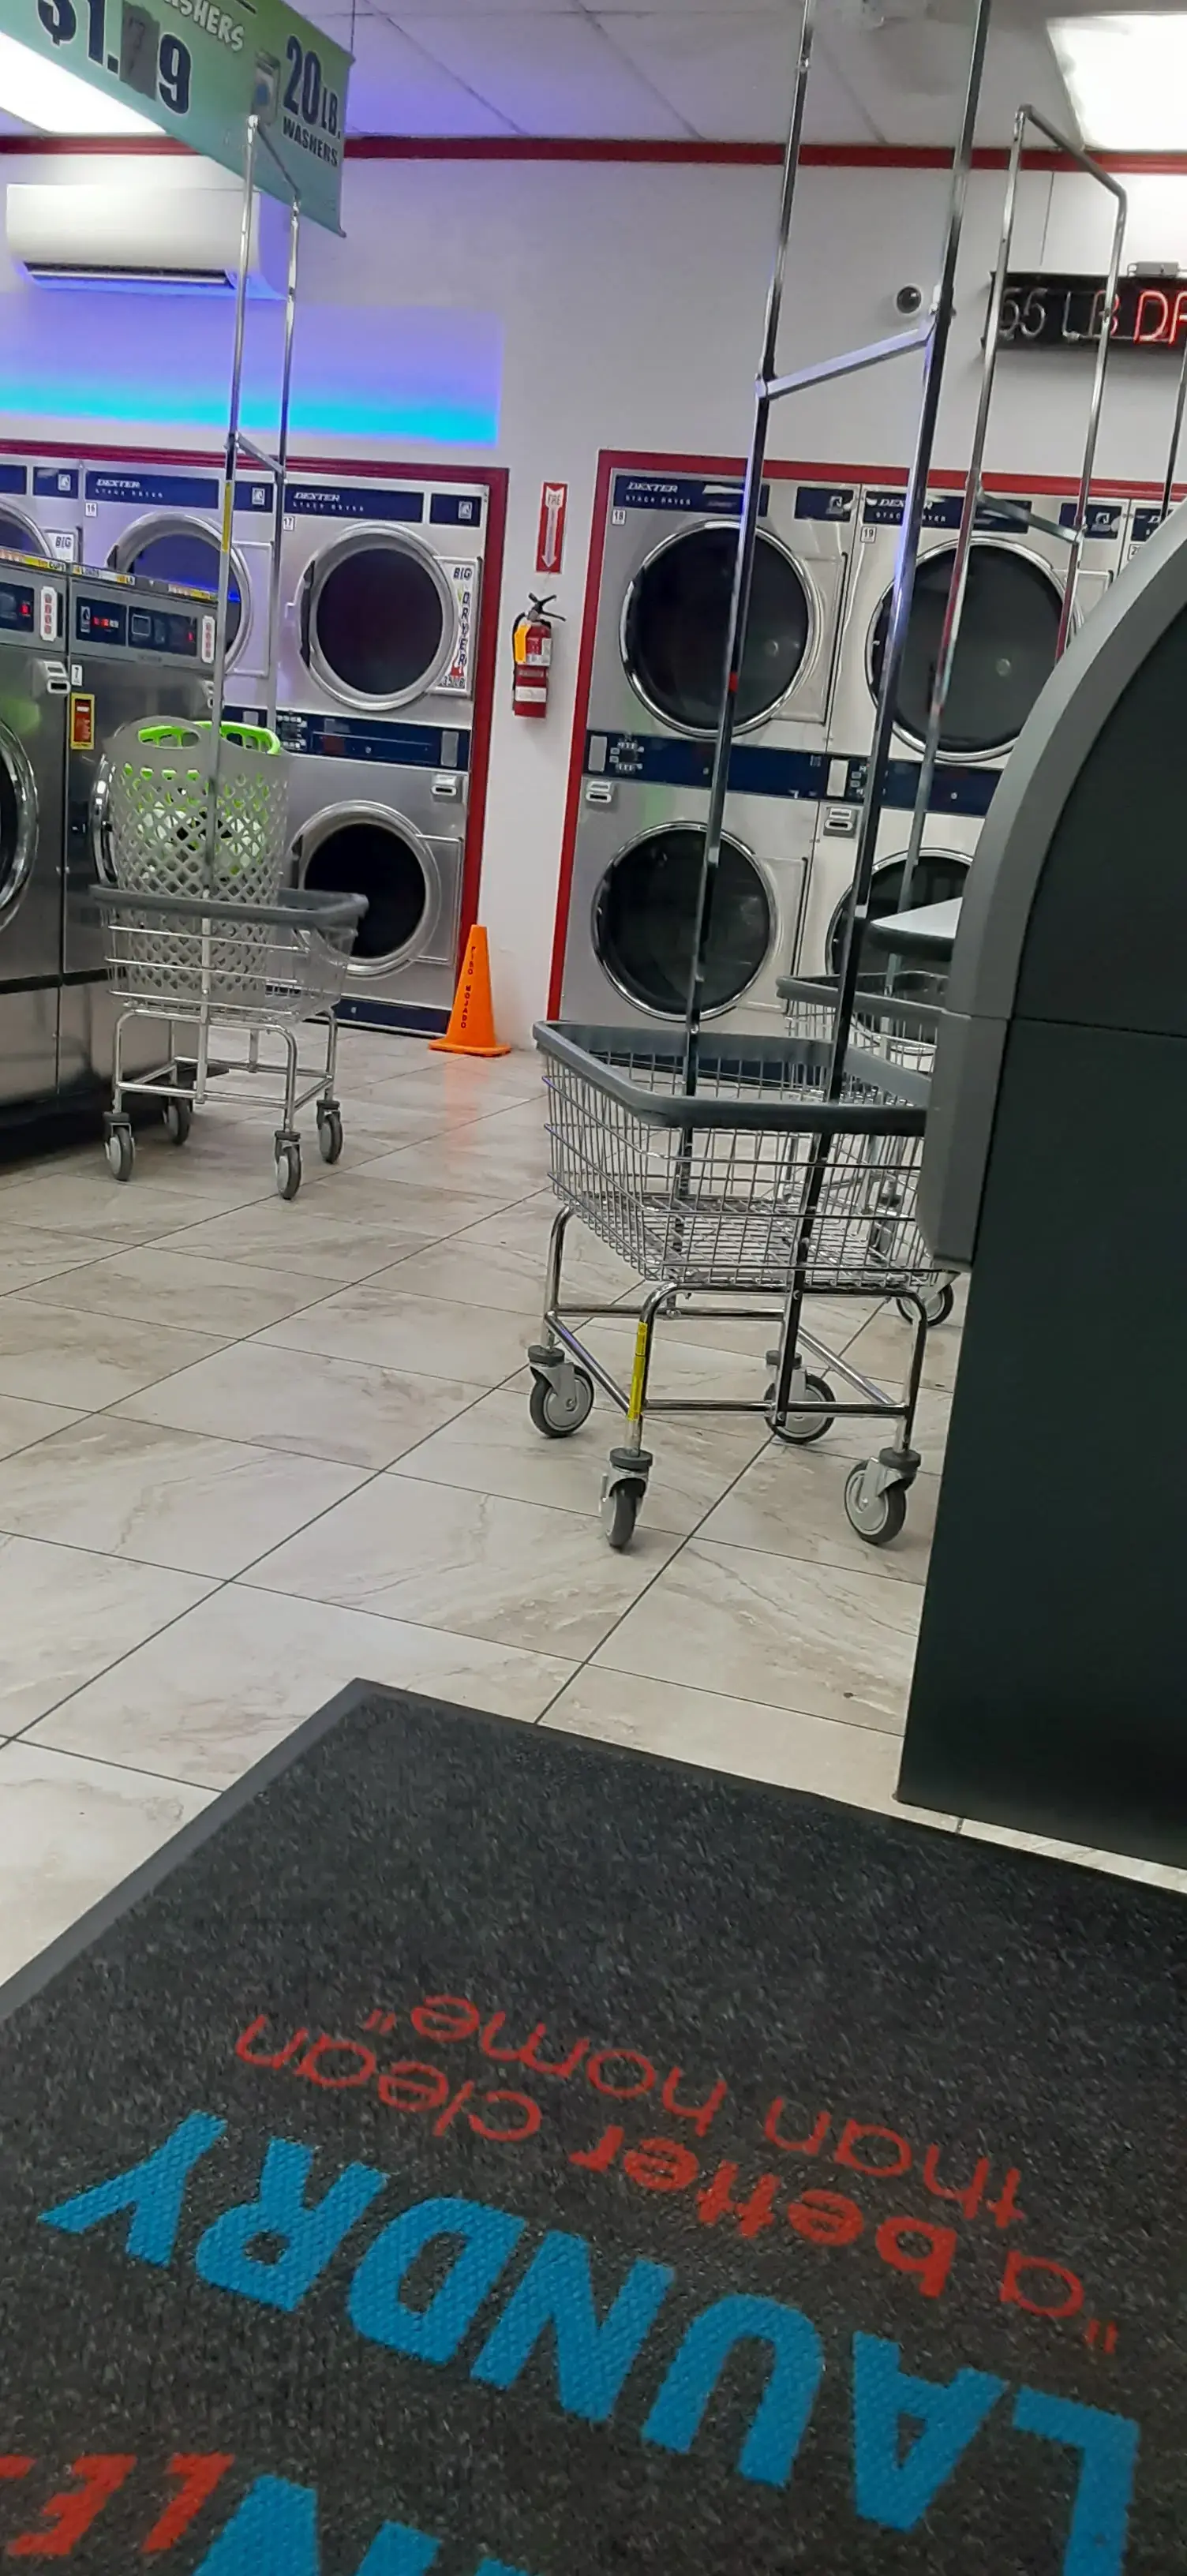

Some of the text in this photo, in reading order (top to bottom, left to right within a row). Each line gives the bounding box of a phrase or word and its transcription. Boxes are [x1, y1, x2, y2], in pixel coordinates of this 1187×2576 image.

[283, 34, 321, 125] 20
[283, 115, 339, 167] WASHERS
[96, 478, 141, 489] DEXTER
[294, 492, 341, 502] DEXTER
[627, 481, 679, 493] DEXTER
[878, 499, 933, 509] DEXR
[55, 537, 72, 549] BIG
[864, 528, 874, 537] 19
[453, 567, 472, 580] BIG
[467, 945, 476, 975] PISO
[460, 984, 472, 1029] MOJADO
[234, 2013, 542, 2144] clean
[764, 2094, 1023, 2231] than
[568, 2125, 957, 2300] better
[36, 2108, 1141, 2576] LAUNDRY
